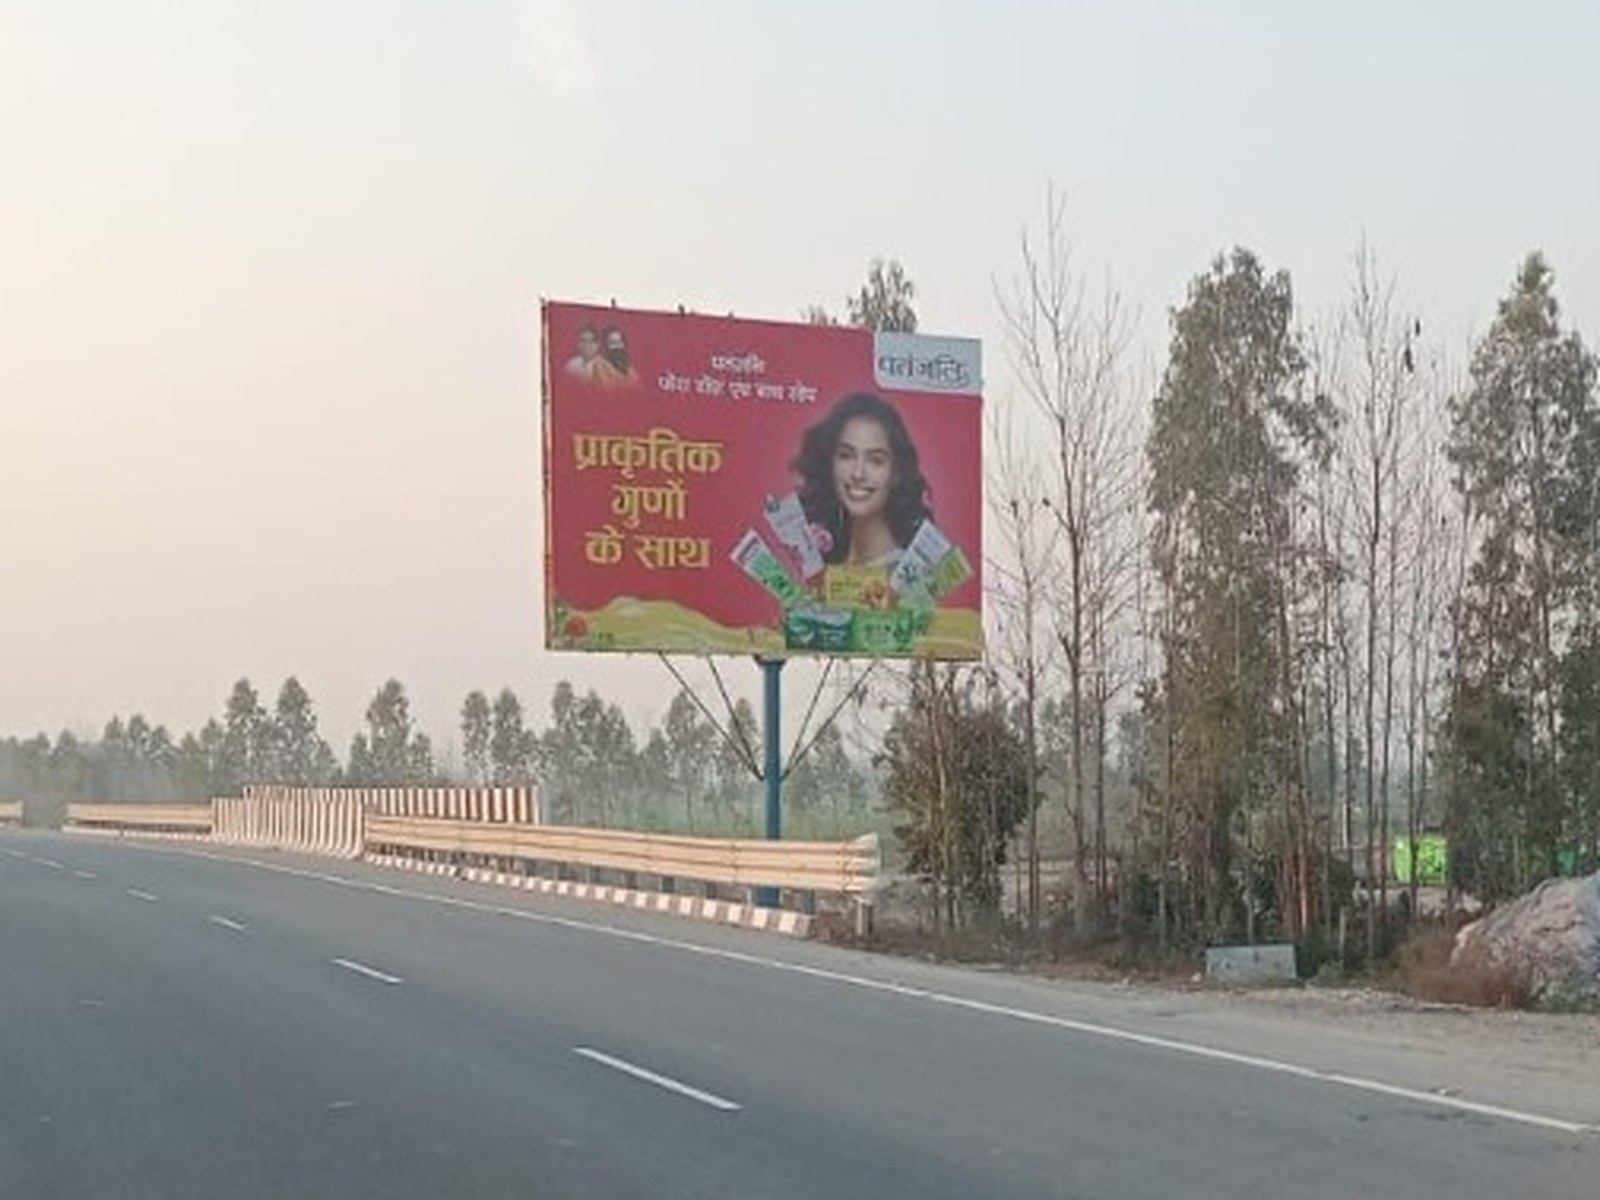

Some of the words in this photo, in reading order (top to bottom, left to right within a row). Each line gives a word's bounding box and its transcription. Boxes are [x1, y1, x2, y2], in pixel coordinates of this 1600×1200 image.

[878, 352, 964, 382] पतंजलि
[573, 427, 724, 479] प्राकृतिक
[611, 478, 688, 529] गुणों
[584, 524, 625, 564] के
[632, 533, 711, 569] साथ
